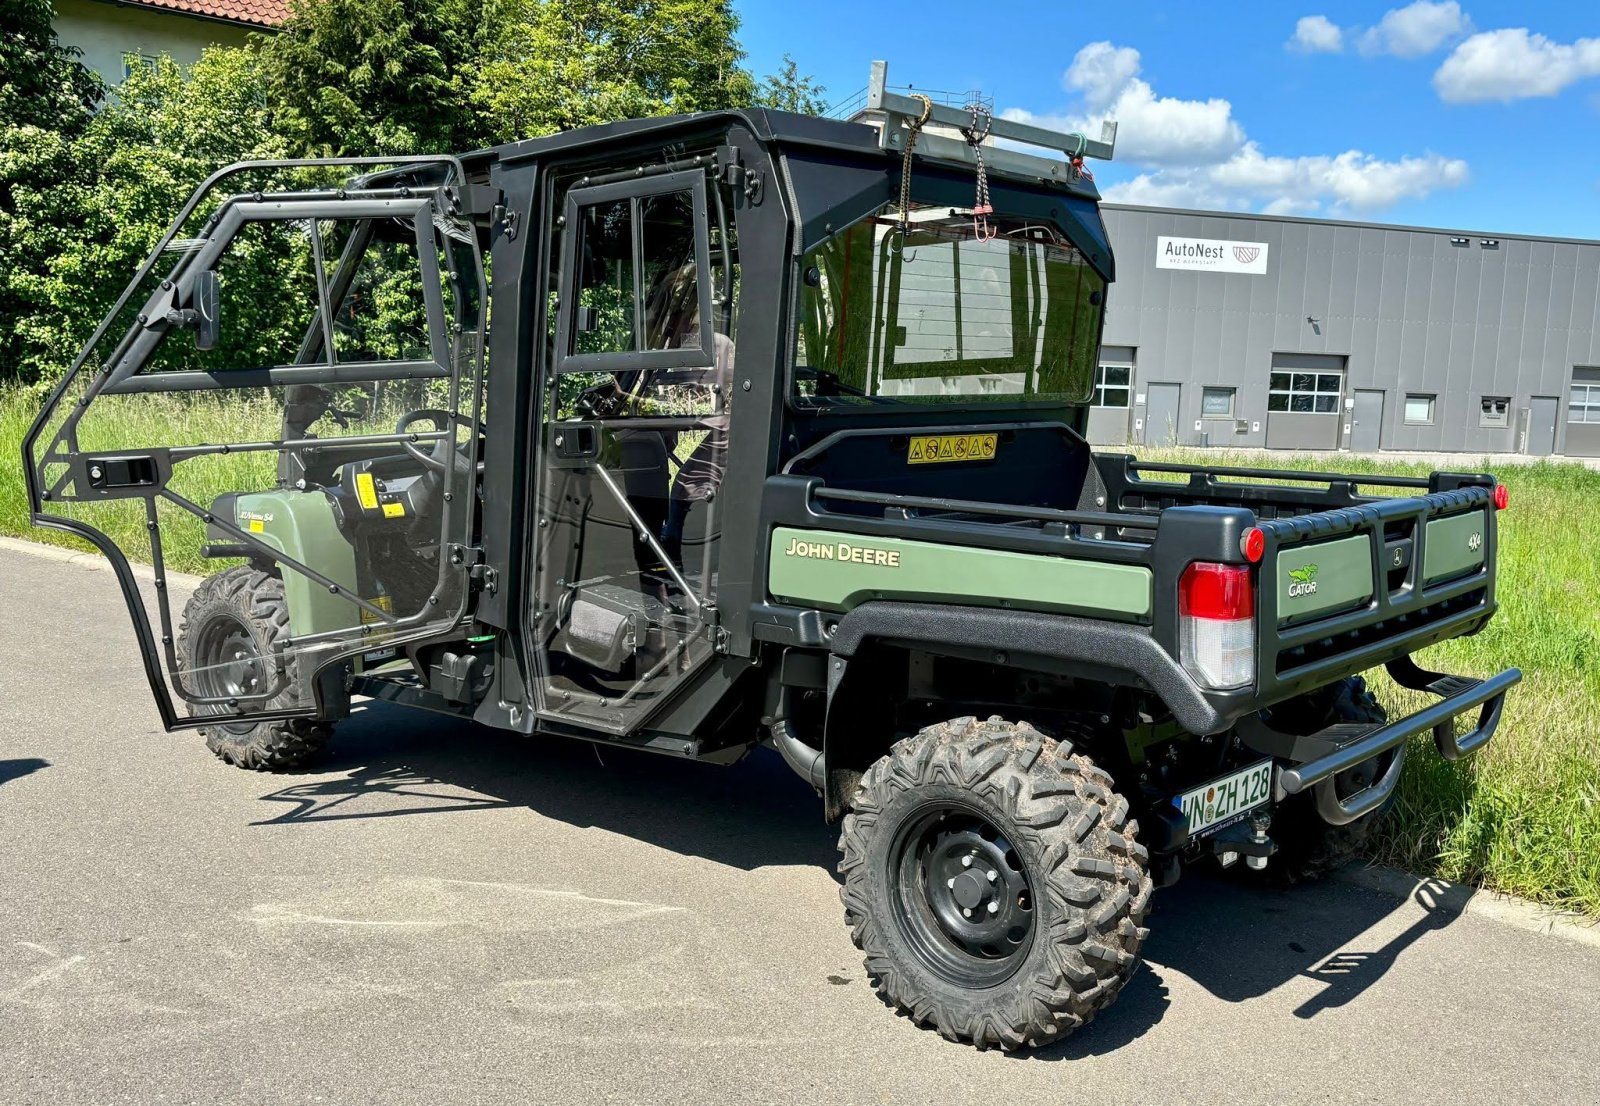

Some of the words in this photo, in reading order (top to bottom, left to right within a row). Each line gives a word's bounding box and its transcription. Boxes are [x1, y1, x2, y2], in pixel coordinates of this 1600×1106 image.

[1165, 241, 1224, 259] AutoNest
[786, 537, 834, 560] JOHN
[837, 543, 900, 567] DEERE
[1288, 581, 1317, 598] GATOR
[1215, 779, 1239, 819] ZH
[1240, 766, 1270, 808] 128
